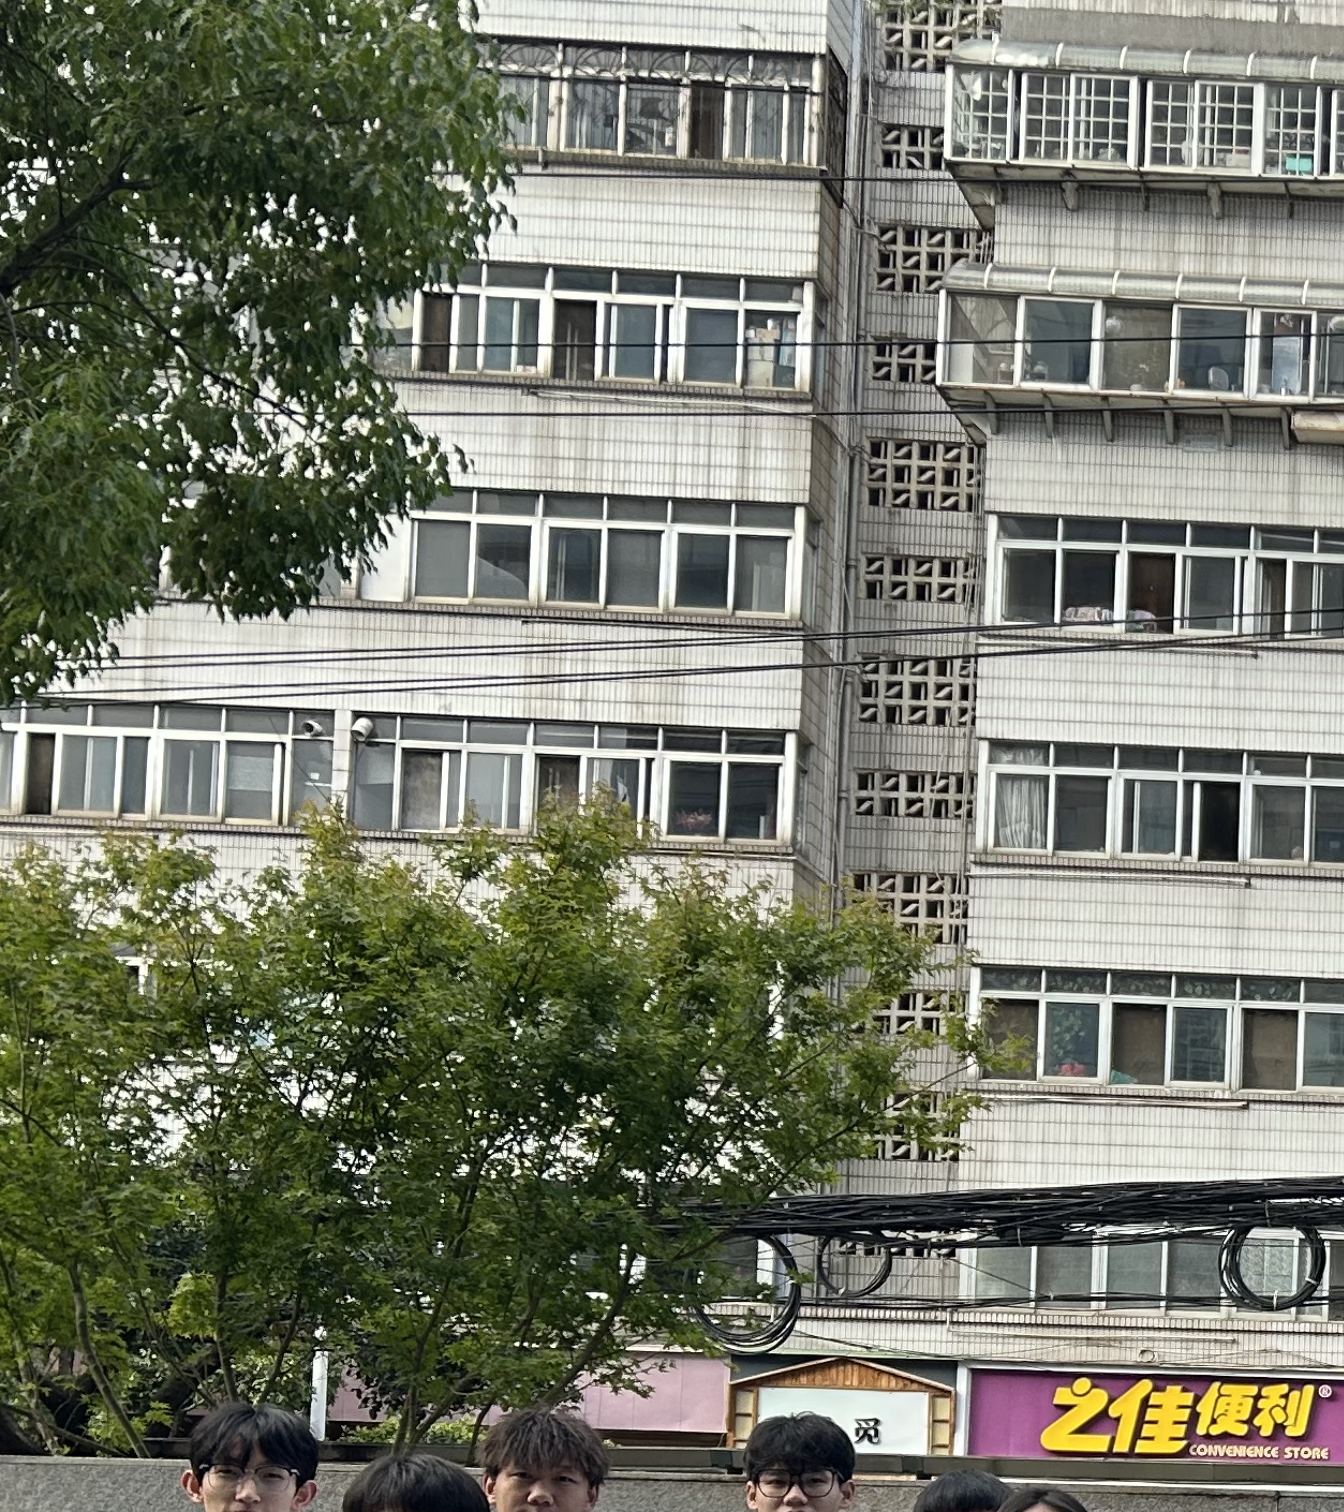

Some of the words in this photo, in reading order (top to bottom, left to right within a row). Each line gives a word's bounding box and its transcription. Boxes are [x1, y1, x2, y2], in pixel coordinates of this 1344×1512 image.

[1040, 1377, 1315, 1454] 之佳便利
[1189, 1444, 1279, 1458] CONVENIENCE
[1283, 1447, 1329, 1460] STORE
